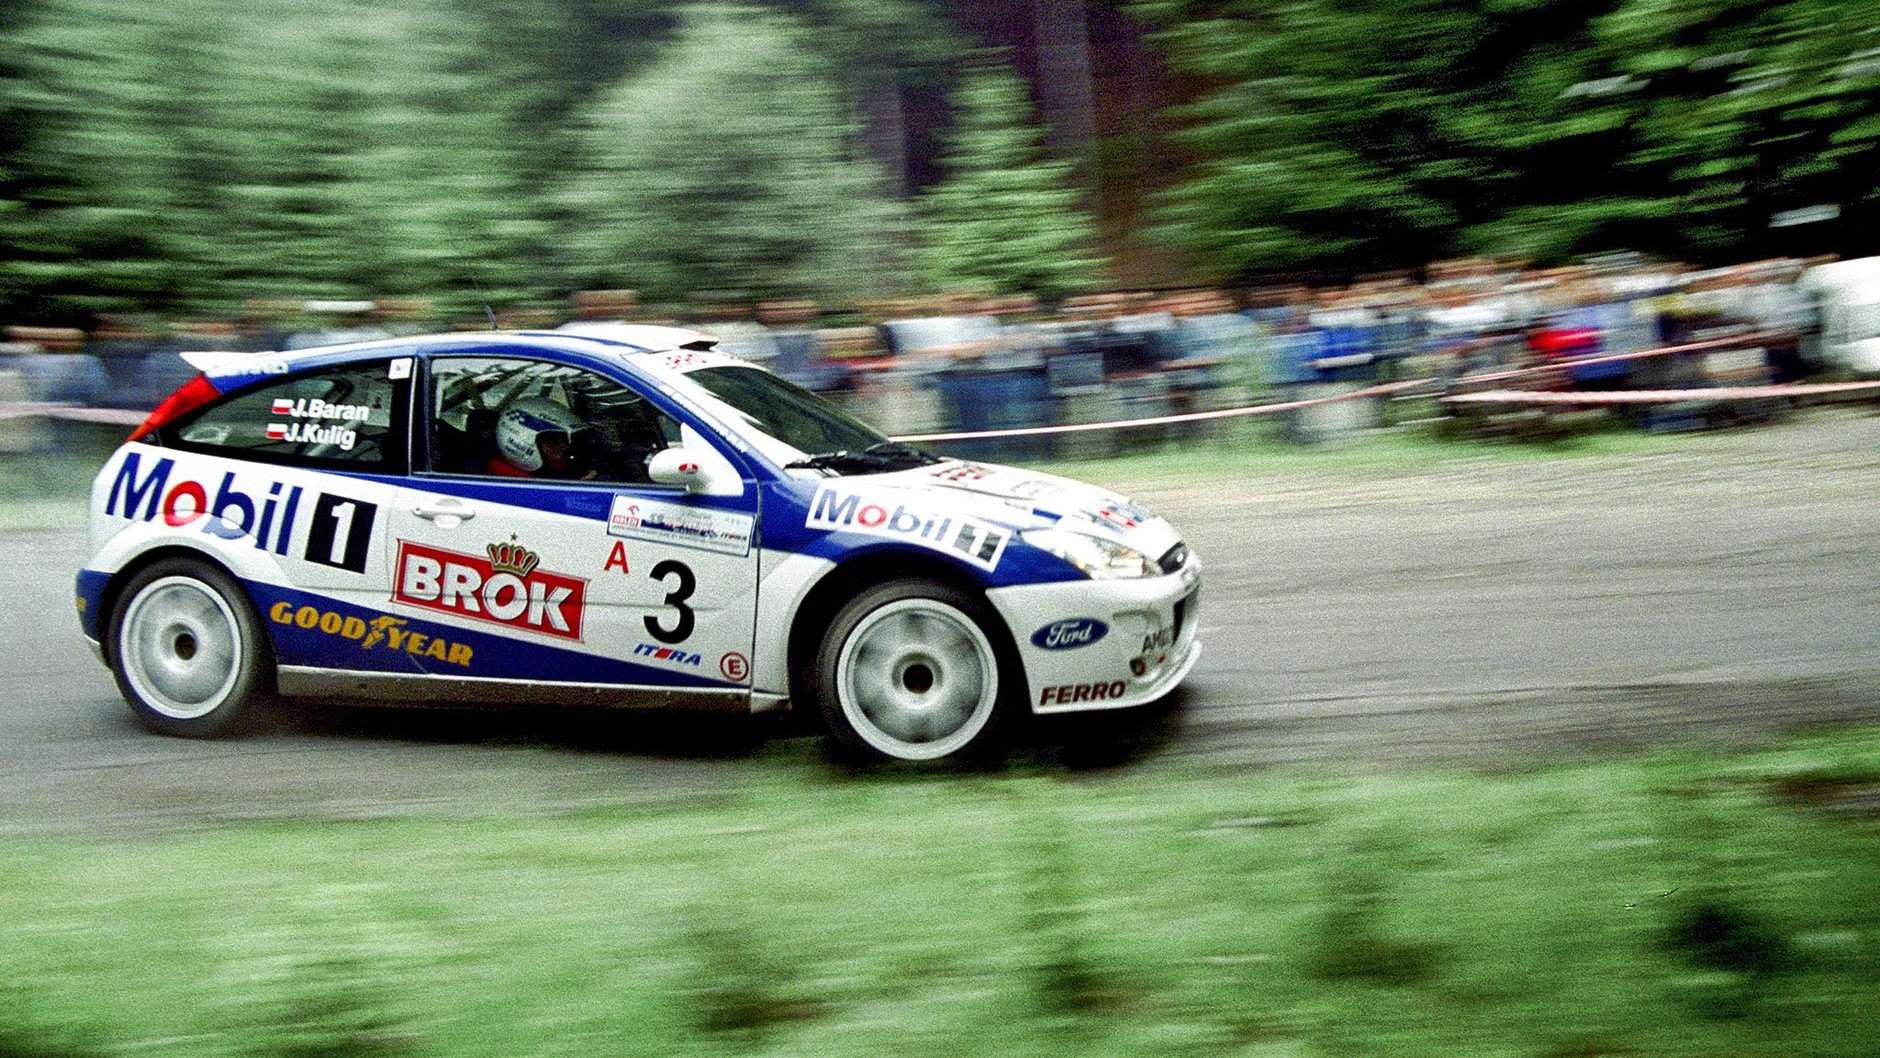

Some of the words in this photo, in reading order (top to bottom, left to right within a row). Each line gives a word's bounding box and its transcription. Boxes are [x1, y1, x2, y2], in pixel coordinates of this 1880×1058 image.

[290, 398, 369, 421] J.Baran
[284, 422, 356, 450] J.Kulig
[106, 452, 302, 555] Mobil
[331, 502, 355, 563] 1
[813, 488, 952, 541] Mobil
[604, 541, 629, 574] A
[403, 553, 572, 632] BROK
[643, 559, 696, 644] 3
[1046, 621, 1093, 648] Ford
[728, 659, 742, 675] E
[1039, 680, 1126, 707] FERRO
